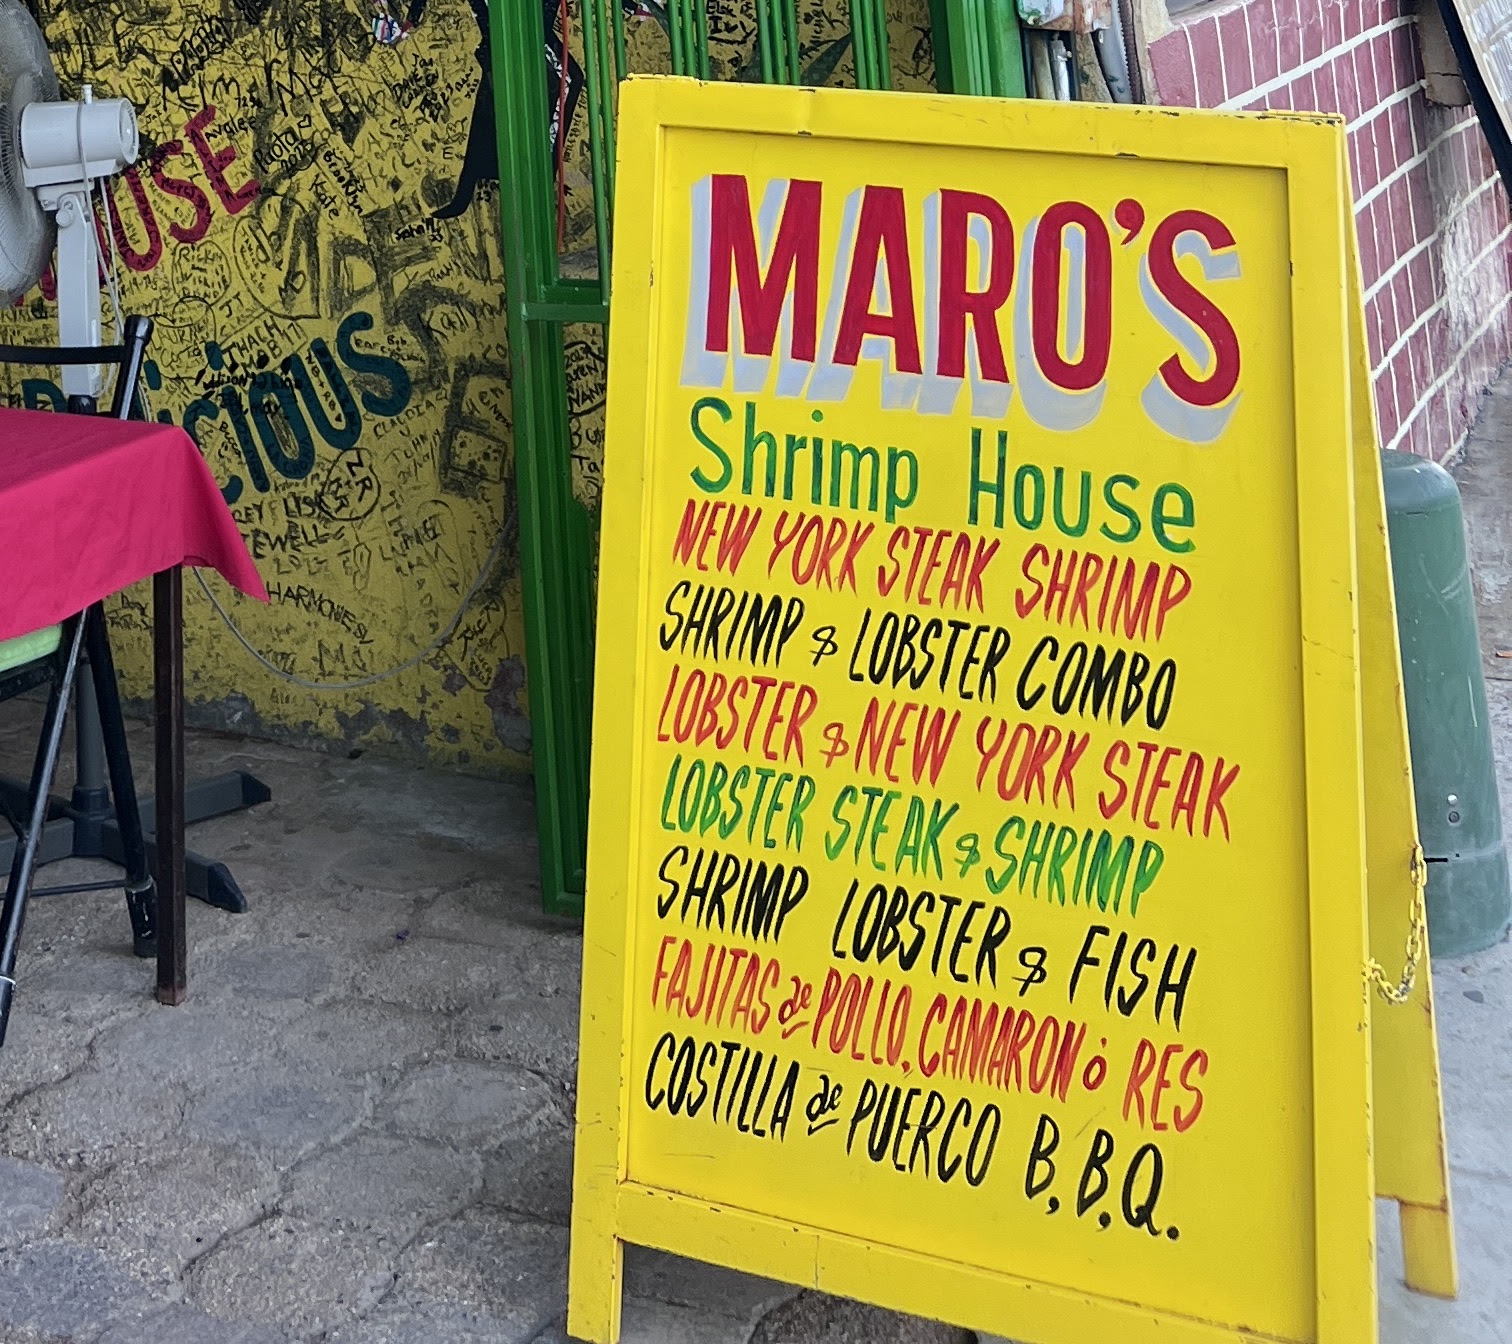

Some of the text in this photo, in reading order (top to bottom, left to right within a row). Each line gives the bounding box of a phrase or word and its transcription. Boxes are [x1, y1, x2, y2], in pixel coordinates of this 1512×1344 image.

[685, 172, 1242, 437] MARO'S
[690, 396, 1197, 554] Shrimp House
[672, 497, 1193, 643] NEW YORK STEAK SHRIMP
[659, 579, 808, 668] SHRIMP
[848, 608, 1010, 692] LOBSTER
[1015, 629, 1178, 730] COMBO
[655, 664, 819, 769] LOBSTER
[853, 695, 962, 790] NEW
[975, 713, 1090, 813] YORK
[1096, 739, 1241, 844] STEAK
[660, 752, 815, 854] LOBSTER
[825, 787, 947, 880] STEAK
[984, 814, 1165, 919] SHRIMP
[655, 844, 810, 947] SHRIMP
[831, 877, 1010, 986] LOBSTER
[1069, 924, 1200, 1031] FISH
[644, 1031, 799, 1144] COSTILLA
[846, 1079, 1003, 1188] PUERCO
[651, 934, 780, 1036] FAJITAS
[917, 994, 1087, 1103] CAMARON
[1123, 1041, 1211, 1135] RES
